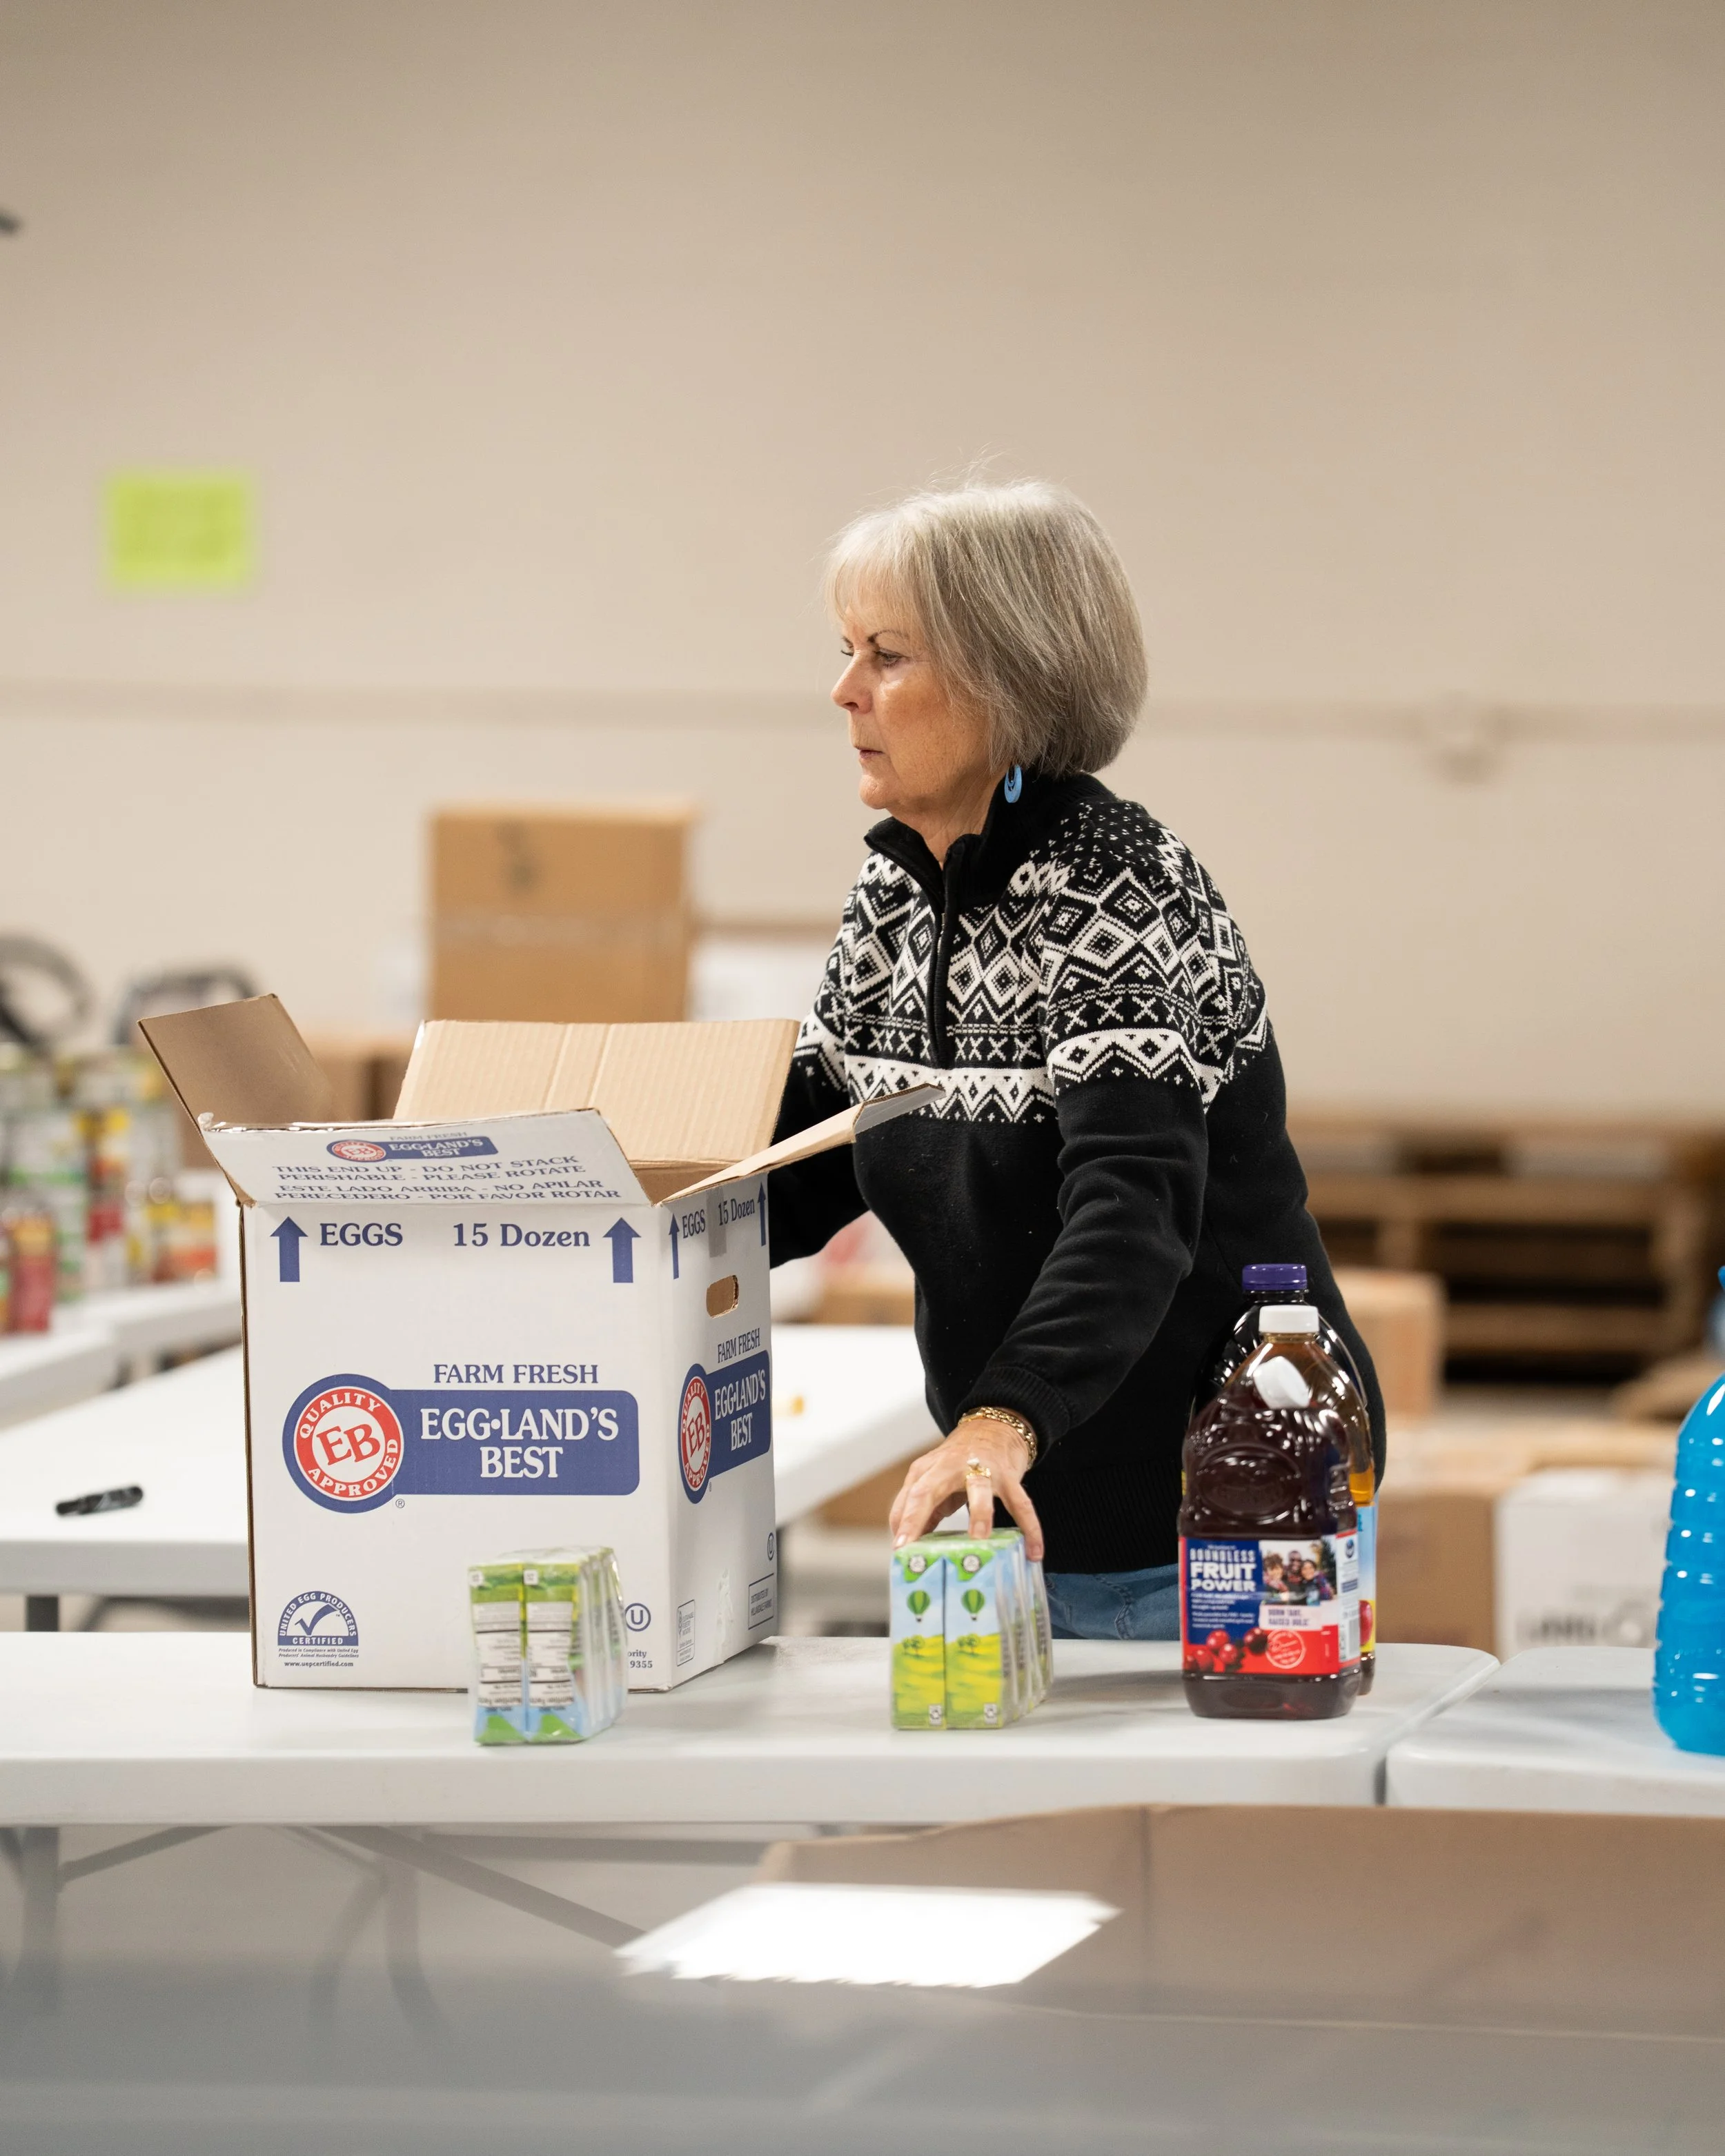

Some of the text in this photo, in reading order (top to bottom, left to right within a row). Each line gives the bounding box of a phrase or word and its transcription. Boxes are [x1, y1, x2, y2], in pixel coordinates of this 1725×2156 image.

[426, 1131, 468, 1140] FRESH
[422, 1148, 461, 1158] BEST
[461, 1162, 502, 1171] NOT
[510, 1156, 580, 1167] STACK
[424, 1171, 500, 1181] PLEASE
[506, 1165, 586, 1178] ROTATE
[532, 1179, 604, 1189] APILAR
[478, 1191, 546, 1200] FAVOR
[551, 1190, 622, 1199] ROTAR
[319, 1223, 591, 1247] EGGS 15 Dozen
[682, 1198, 756, 1239] EGGS 15 Dozen
[718, 1327, 760, 1364] FARM FRESH
[433, 1364, 599, 1384] FARM FRESH
[299, 1392, 381, 1440] QUALITY
[682, 1381, 705, 1434] QUALITY
[316, 1423, 382, 1466] EB
[687, 1412, 705, 1458] EB
[731, 1412, 753, 1452] BEST
[308, 1437, 399, 1496] APPROVED
[480, 1445, 564, 1478] BEST
[684, 1423, 711, 1486] APPROVED
[1190, 1561, 1256, 1580] FRUIT
[1190, 1579, 1256, 1592] POWER
[279, 1592, 357, 1636] UNITED EGG PRODUCERS
